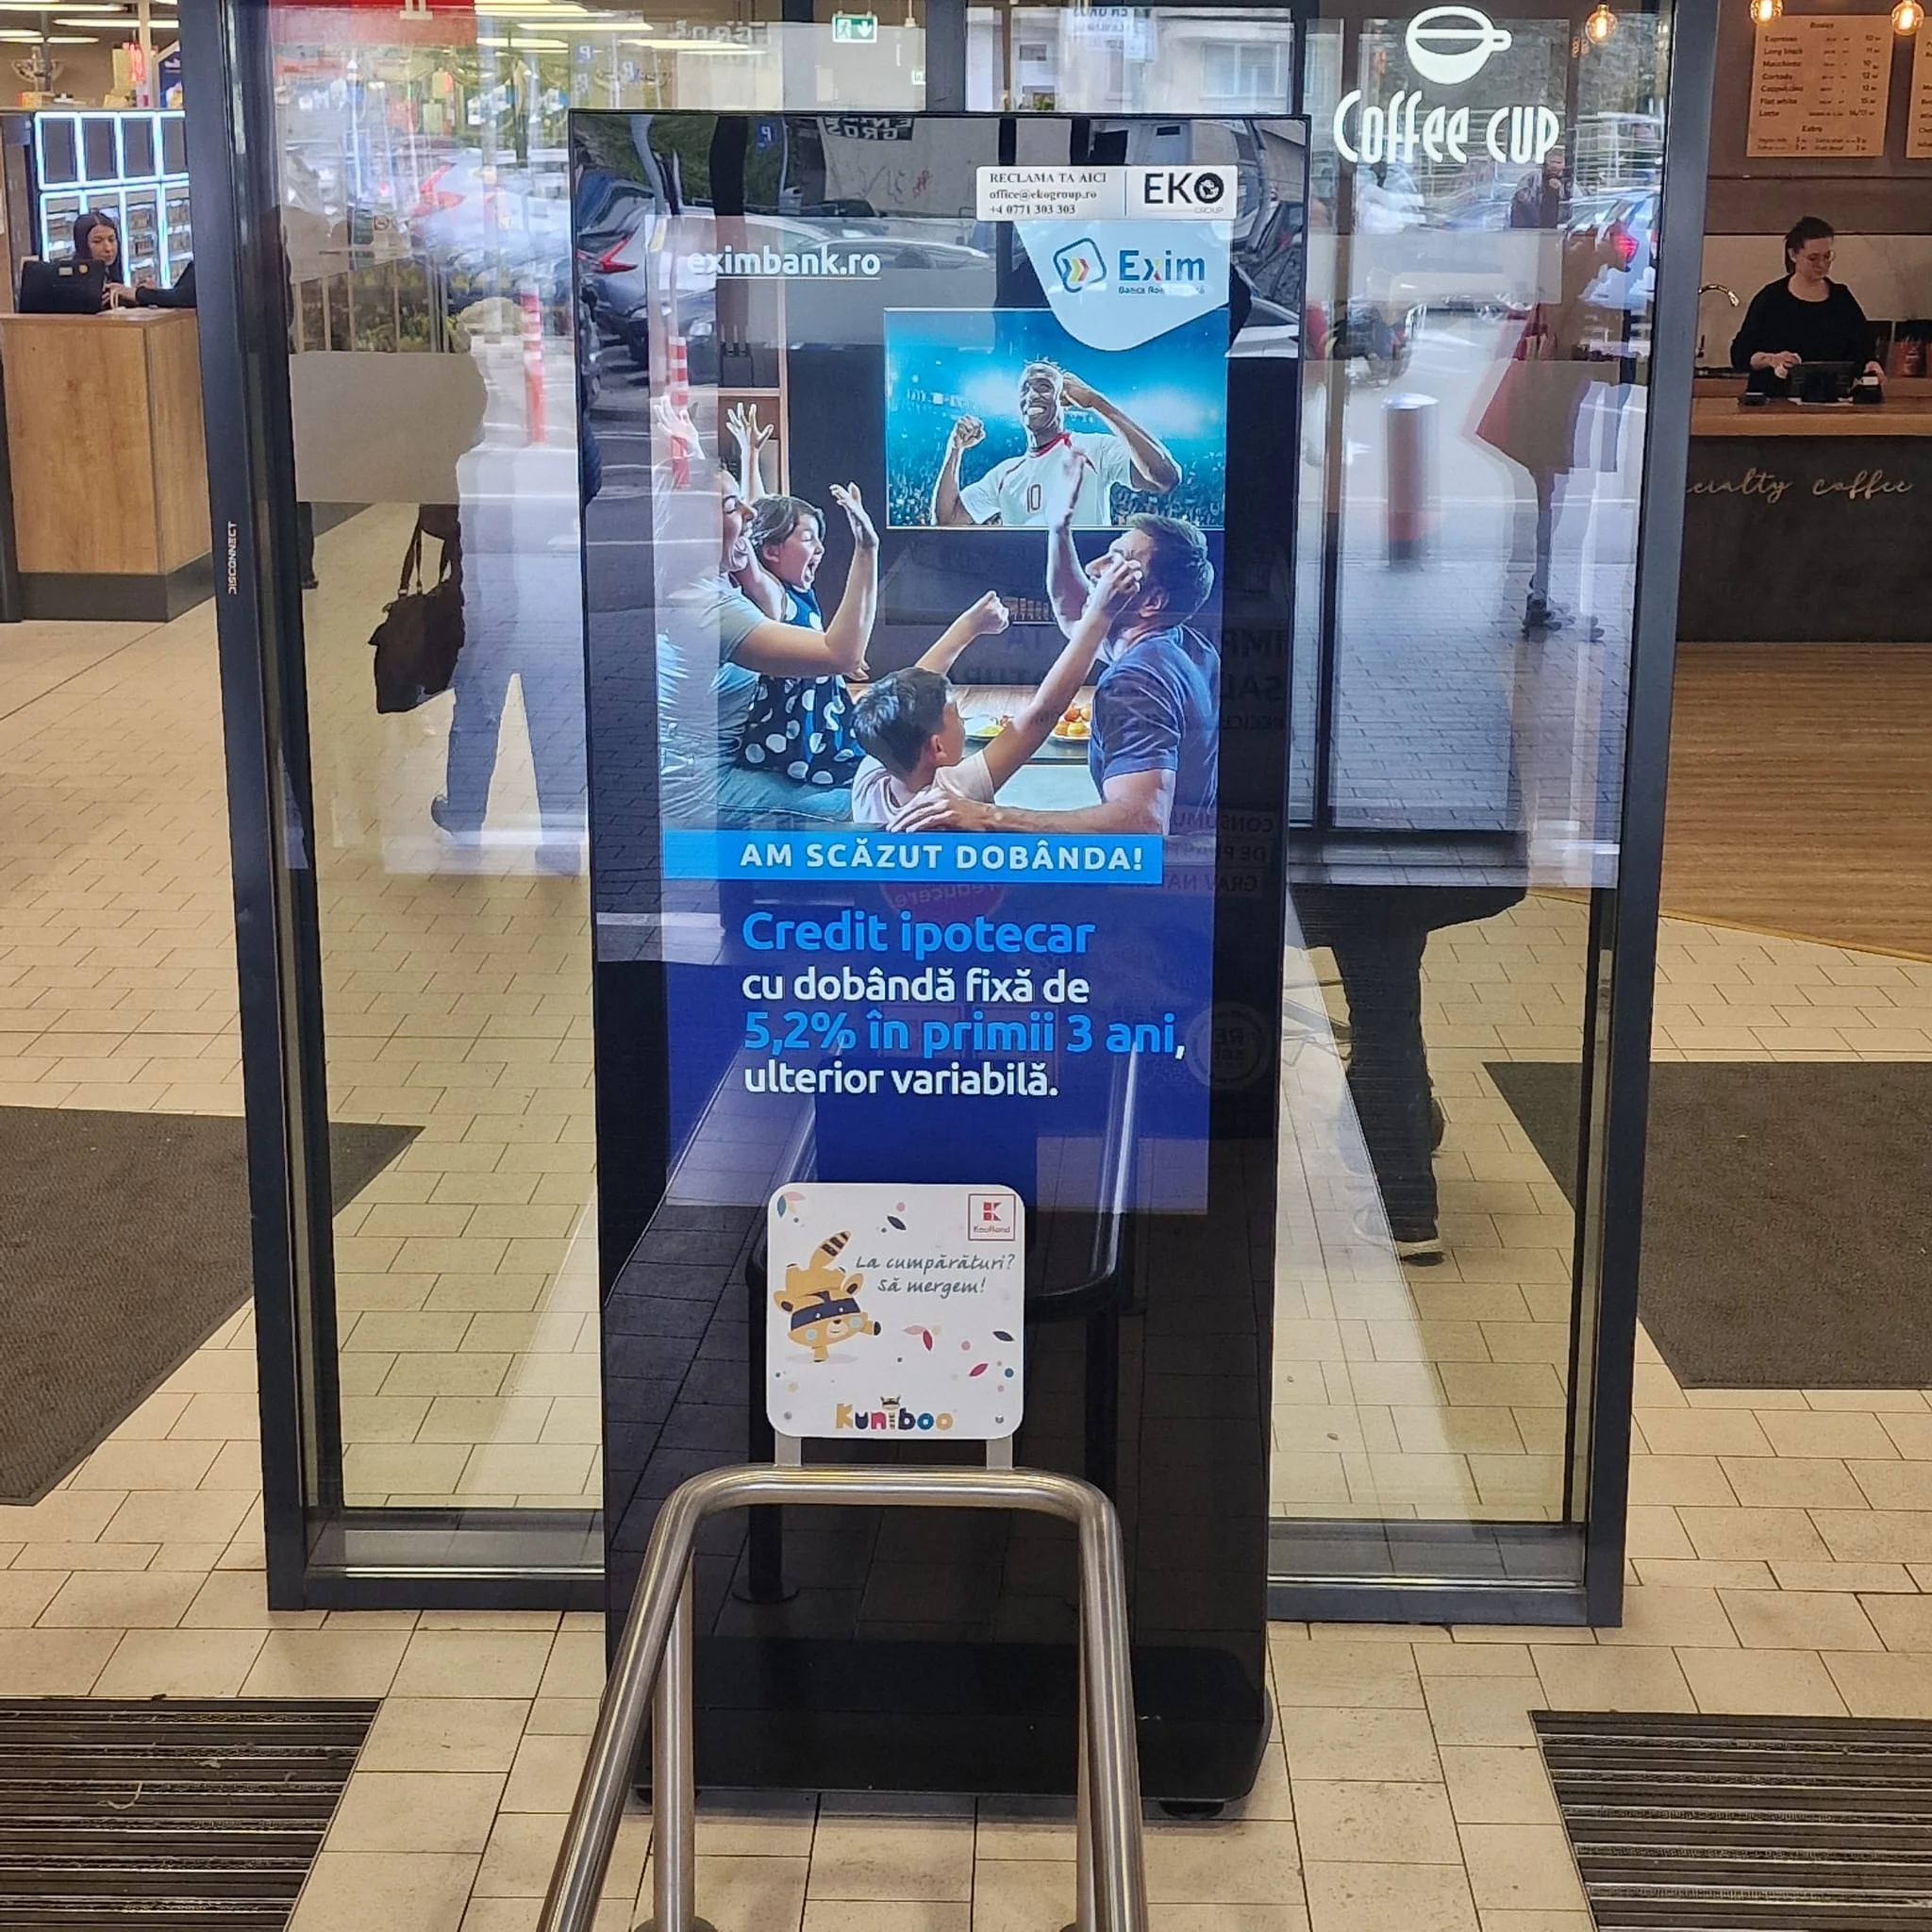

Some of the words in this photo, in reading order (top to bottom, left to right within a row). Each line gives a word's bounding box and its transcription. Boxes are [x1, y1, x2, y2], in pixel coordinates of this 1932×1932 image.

[1333, 89, 1470, 164] Coffee
[989, 172, 1055, 184] RECLAMA
[1059, 172, 1075, 184] TA
[1078, 172, 1108, 184] AICI
[1143, 172, 1225, 205] EKO
[989, 189, 1098, 201] office@ekogroup.ro
[990, 204, 1004, 215] +4
[1006, 204, 1031, 215] 0771
[1036, 204, 1055, 215] 303
[1056, 204, 1075, 215] 303
[687, 244, 882, 275] eximbank.ro
[1118, 249, 1206, 282] Exim
[1026, 483, 1041, 513] 10
[1811, 469, 1914, 500] coffee
[740, 842, 792, 868] AM
[806, 838, 943, 870] SCĂZUT
[956, 840, 1143, 872] DOBÂNDA!
[741, 909, 889, 953] Credit
[901, 909, 1096, 961] ipotecar
[741, 973, 784, 1001] cu
[792, 966, 957, 1003] dobândă
[966, 966, 1033, 1004] fixă
[1042, 968, 1091, 1004] de
[743, 1010, 857, 1057] 5,2%
[865, 1011, 909, 1051] în
[924, 1010, 1054, 1058] primii
[1065, 1013, 1093, 1053] 3
[1105, 1012, 1186, 1060] ani,
[743, 1058, 885, 1095] ulterior
[891, 1061, 1059, 1097] variabilă.
[855, 1255, 881, 1270] La
[886, 1253, 1016, 1275] cumpărături?
[876, 1276, 902, 1293] Să
[907, 1276, 987, 1300] mergem!
[836, 1398, 955, 1432] Kuniboo
